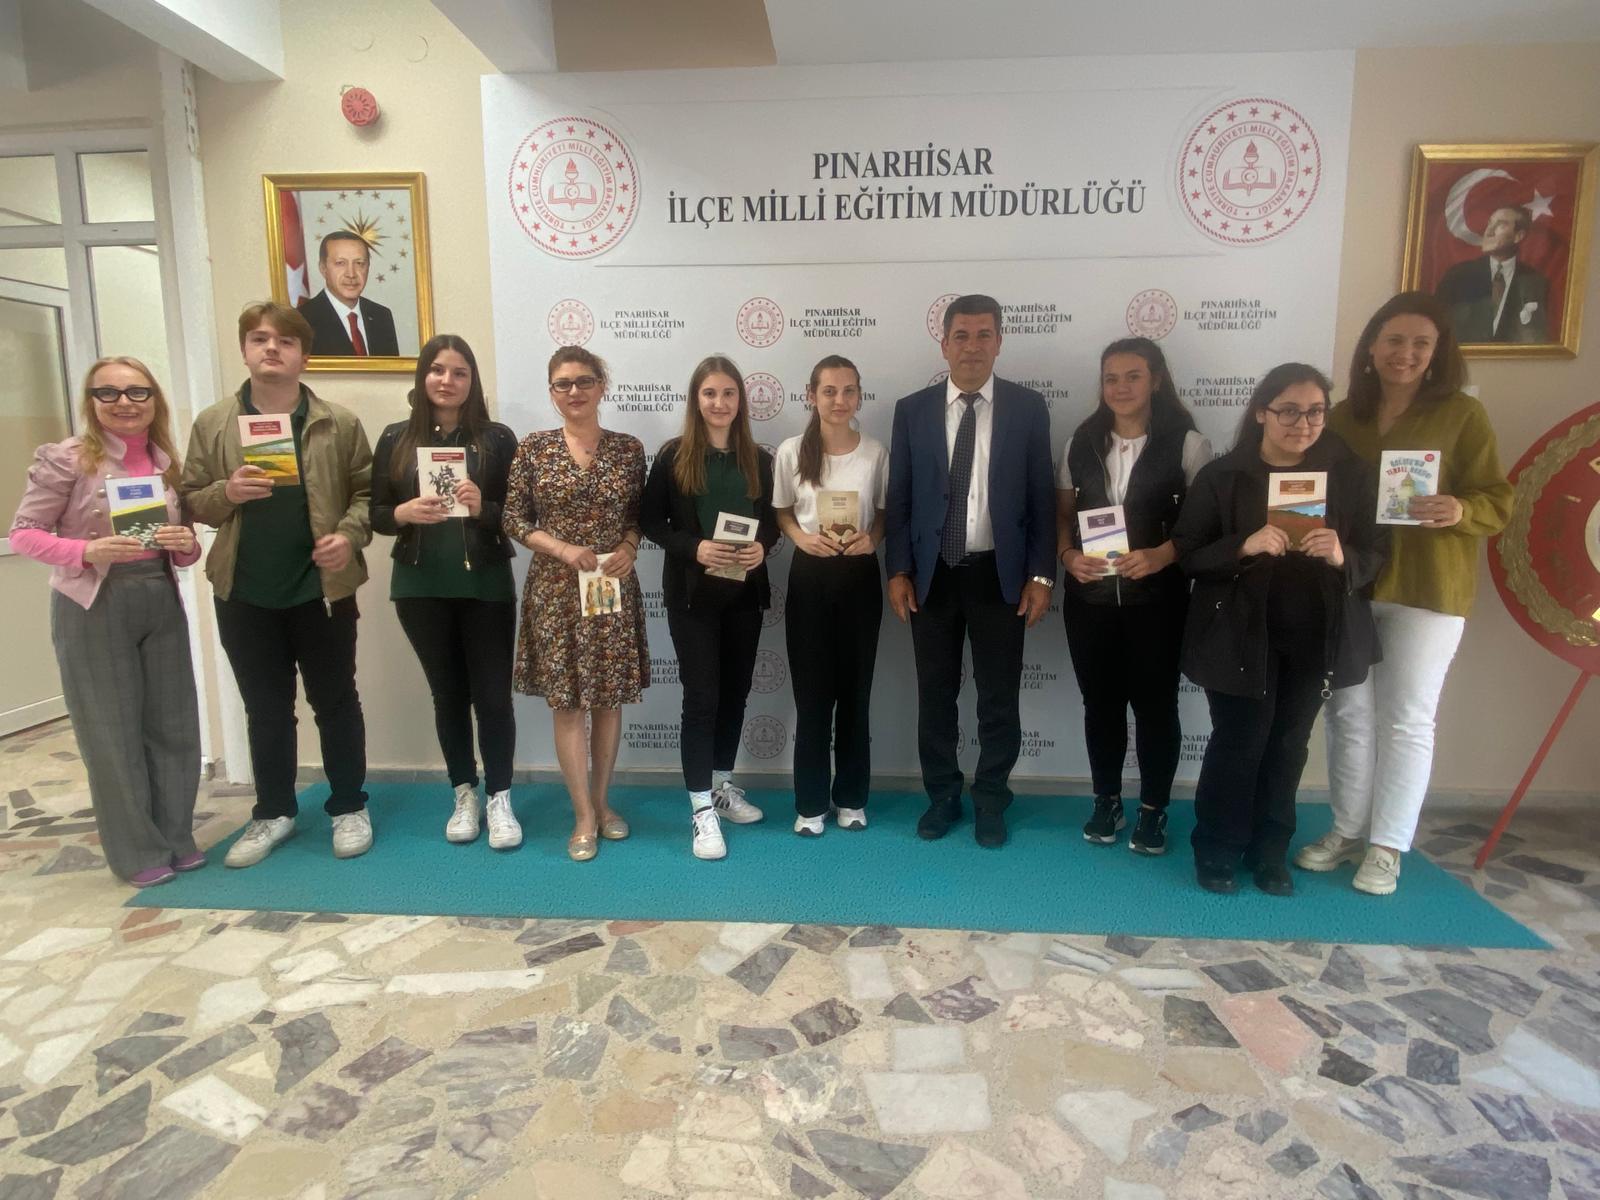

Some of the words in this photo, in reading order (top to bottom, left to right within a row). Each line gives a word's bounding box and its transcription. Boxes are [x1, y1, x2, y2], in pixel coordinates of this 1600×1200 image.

[1206, 125, 1248, 183] CUMHURİYETİ
[1250, 124, 1276, 138] MİLLİ
[1276, 134, 1296, 168] EĞİTİM
[812, 142, 994, 180] PINARHİSAR
[532, 143, 566, 197] CUMHURİYETİ
[568, 142, 593, 157] MİLLİ
[592, 153, 614, 185] EĞİTİM
[667, 190, 734, 230] İLÇE
[741, 187, 827, 223] MİLLİ
[834, 184, 942, 221] EĞİTİM
[950, 177, 1147, 218] MÜDÜRLÜĞÜ
[1201, 298, 1261, 309] PINARHİSAR
[615, 309, 670, 318] PINARHİSAR
[805, 307, 861, 317] PINARHİSAR
[1184, 310, 1205, 321] İLÇE
[1209, 310, 1238, 319] MİLLİ
[1241, 309, 1277, 319] EĞİTİM
[790, 318, 811, 328] İLÇE
[813, 317, 840, 327] MİLLİ
[842, 317, 876, 327] EĞİTİM
[1006, 314, 1034, 324] MİLLİ
[1037, 313, 1072, 323] EĞİTİM
[600, 320, 621, 330] İLÇE
[623, 320, 651, 329] MİLLİ
[652, 319, 685, 329] EĞİTİM
[1198, 320, 1262, 330] MÜDÜRLÜĞÜ
[614, 330, 672, 339] MÜDÜRLÜĞÜ
[803, 328, 862, 338] MÜDÜRLÜĞÜ
[1196, 376, 1255, 386] PINARHİSAR
[618, 383, 672, 392] PINARHİSAR
[1180, 388, 1201, 397] İLÇE
[1204, 387, 1234, 396] MİLLİ
[626, 393, 652, 402] MİLLİ
[654, 392, 687, 402] EĞİTİM
[617, 403, 674, 412] MÜDÜRLÜĞÜ
